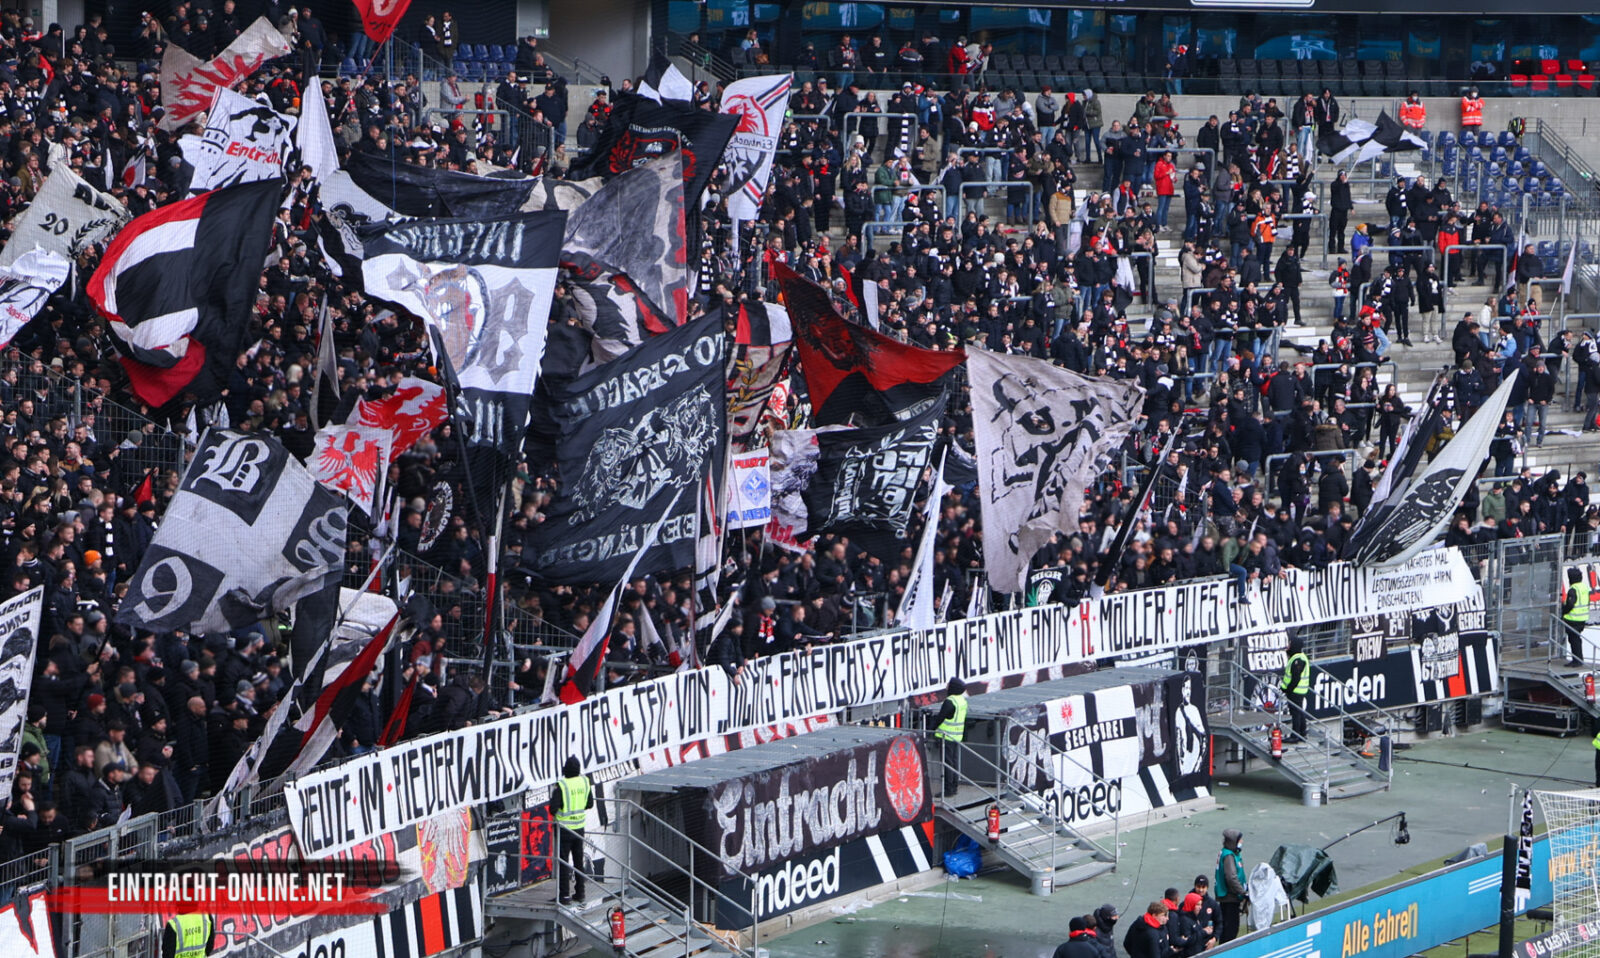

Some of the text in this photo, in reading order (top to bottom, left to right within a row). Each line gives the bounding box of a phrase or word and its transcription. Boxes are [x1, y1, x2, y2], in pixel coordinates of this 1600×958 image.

[38, 212, 69, 236] 20
[1435, 553, 1449, 566] MAL
[1031, 569, 1063, 583] HIGH
[1433, 569, 1453, 584] HIRN
[1357, 635, 1383, 662] CREW
[1314, 667, 1386, 711] finden
[298, 773, 355, 854] HEUTE
[359, 762, 386, 836] IM
[580, 696, 618, 769] DER
[676, 669, 710, 740] VON
[780, 643, 868, 719] ERREICHT
[892, 627, 947, 697] FRÜHER
[954, 618, 988, 679] WEG
[996, 612, 1024, 672] MIT
[1032, 607, 1071, 666] ANDY
[1175, 583, 1220, 641] ALLES
[1260, 569, 1304, 627] AUCH
[1308, 563, 1368, 620] PRIVAT!
[713, 750, 882, 876] Eintracht
[750, 846, 841, 917] indeed
[1342, 902, 1419, 958] Alle fahren
[1533, 941, 1543, 956] LG
